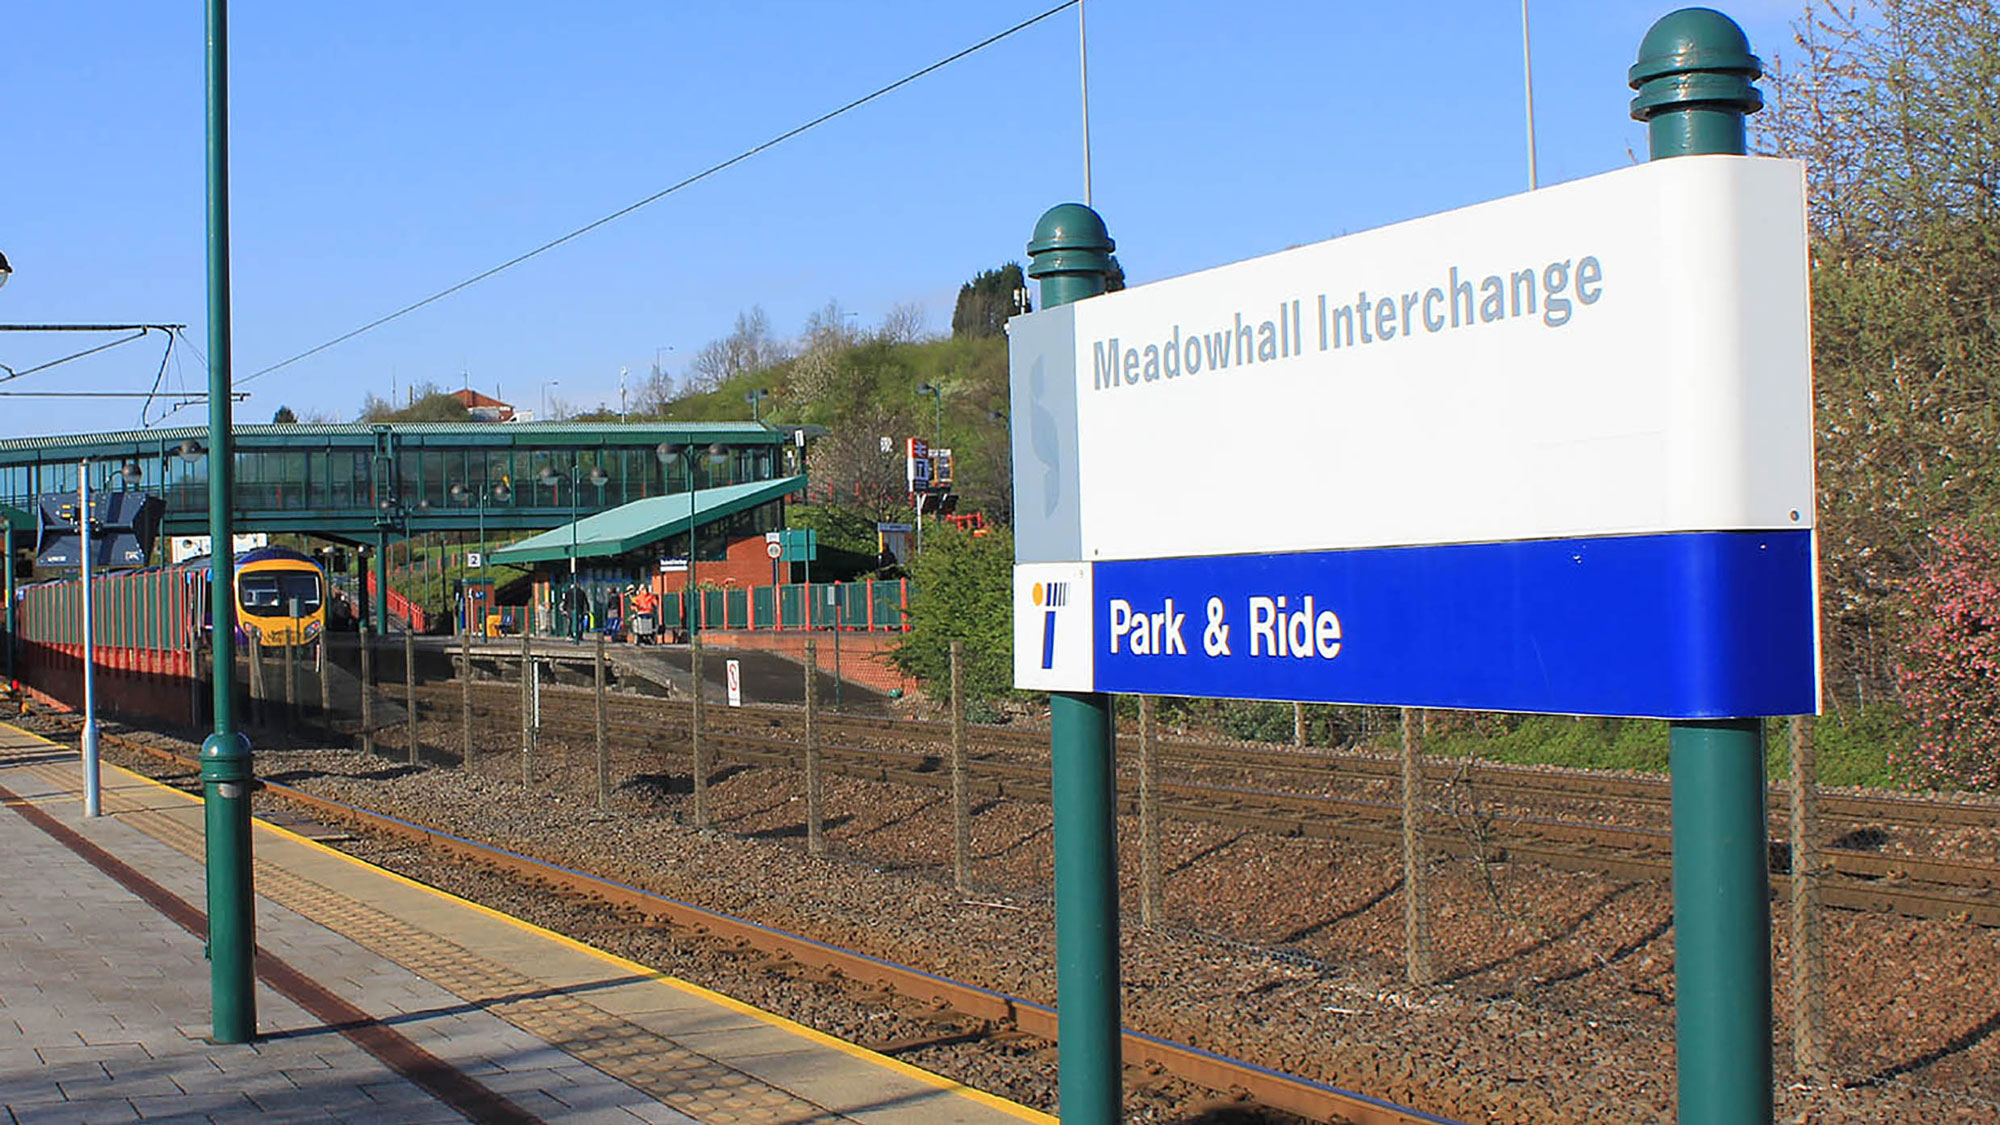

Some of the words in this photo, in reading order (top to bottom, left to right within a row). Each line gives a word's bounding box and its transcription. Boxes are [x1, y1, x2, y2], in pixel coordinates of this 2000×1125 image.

[1093, 299, 1301, 391] Meadowhall
[1318, 255, 1603, 352] Interchange
[470, 555, 478, 565] 2
[1109, 598, 1188, 655] Park
[1203, 596, 1232, 658] &
[1249, 595, 1343, 660] Ride
